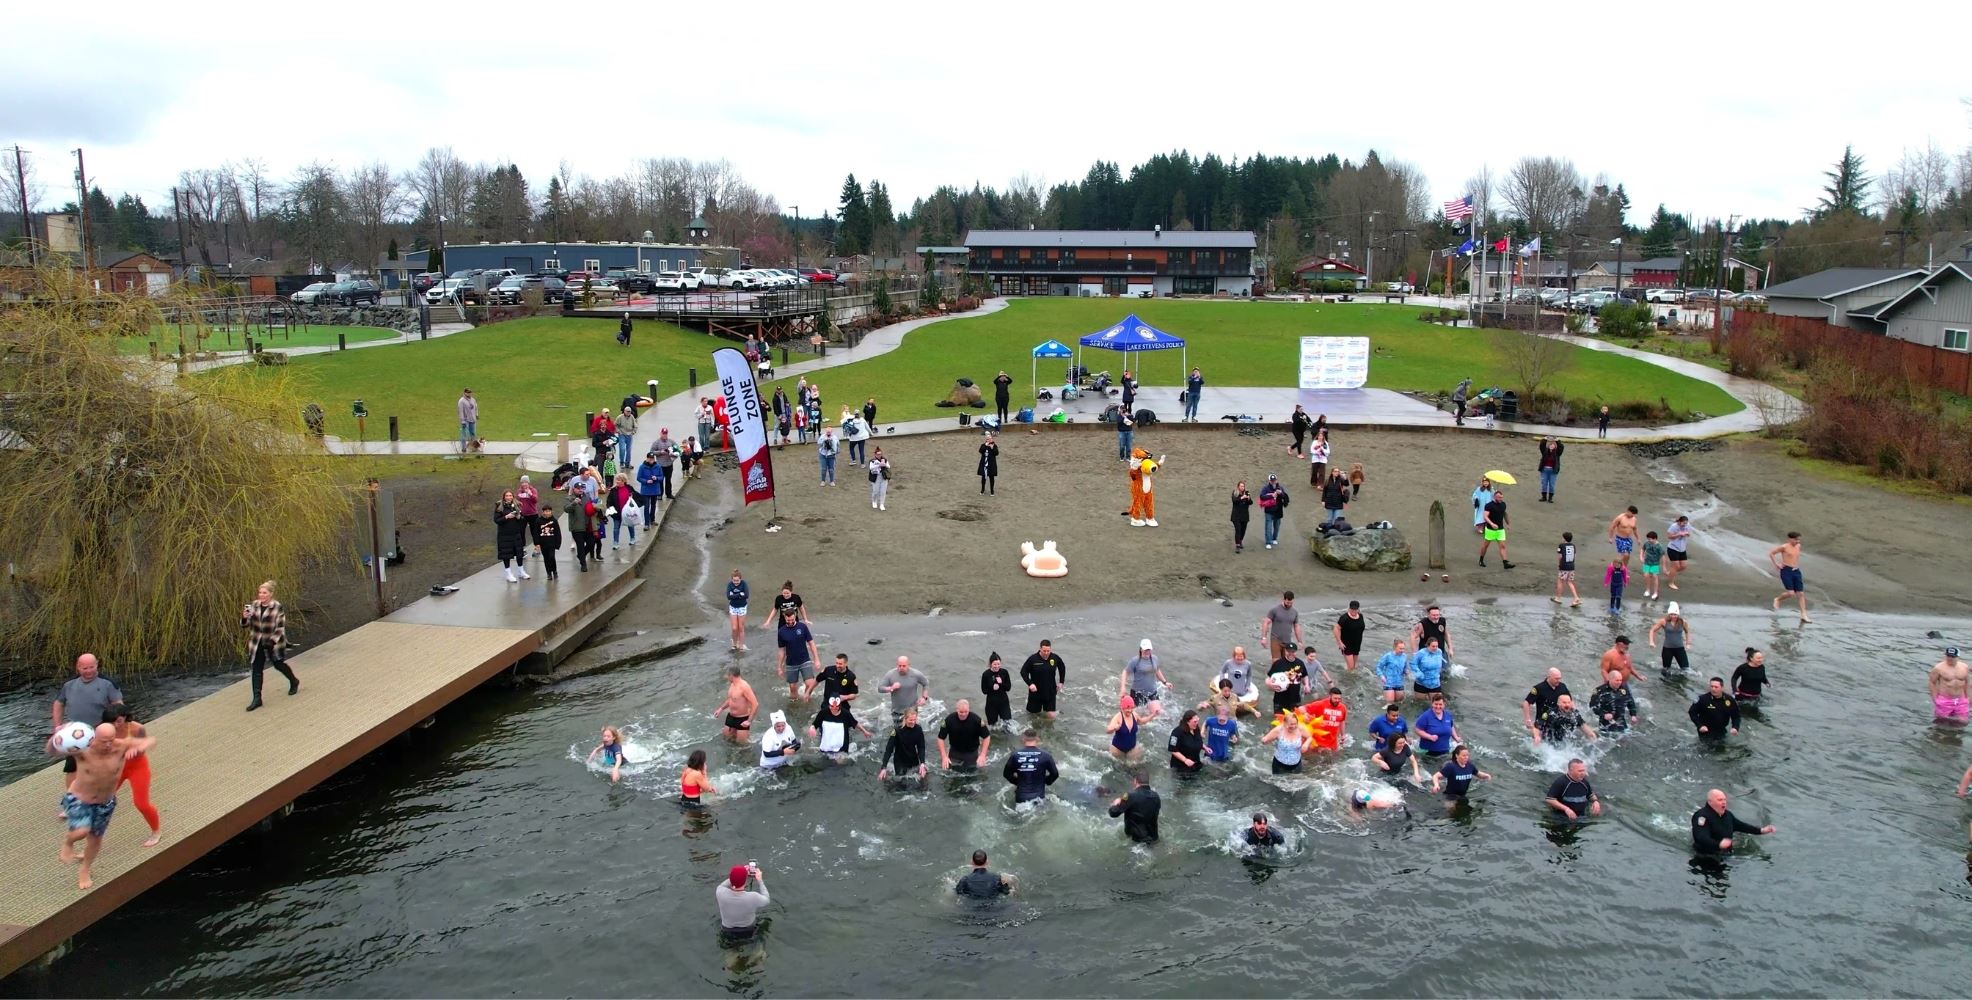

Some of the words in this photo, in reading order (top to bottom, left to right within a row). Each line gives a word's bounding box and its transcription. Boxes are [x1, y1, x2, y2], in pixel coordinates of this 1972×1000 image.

[1142, 342, 1165, 350] STEVENS
[722, 376, 744, 435] PLUNGE
[740, 379, 759, 420] ZONE
